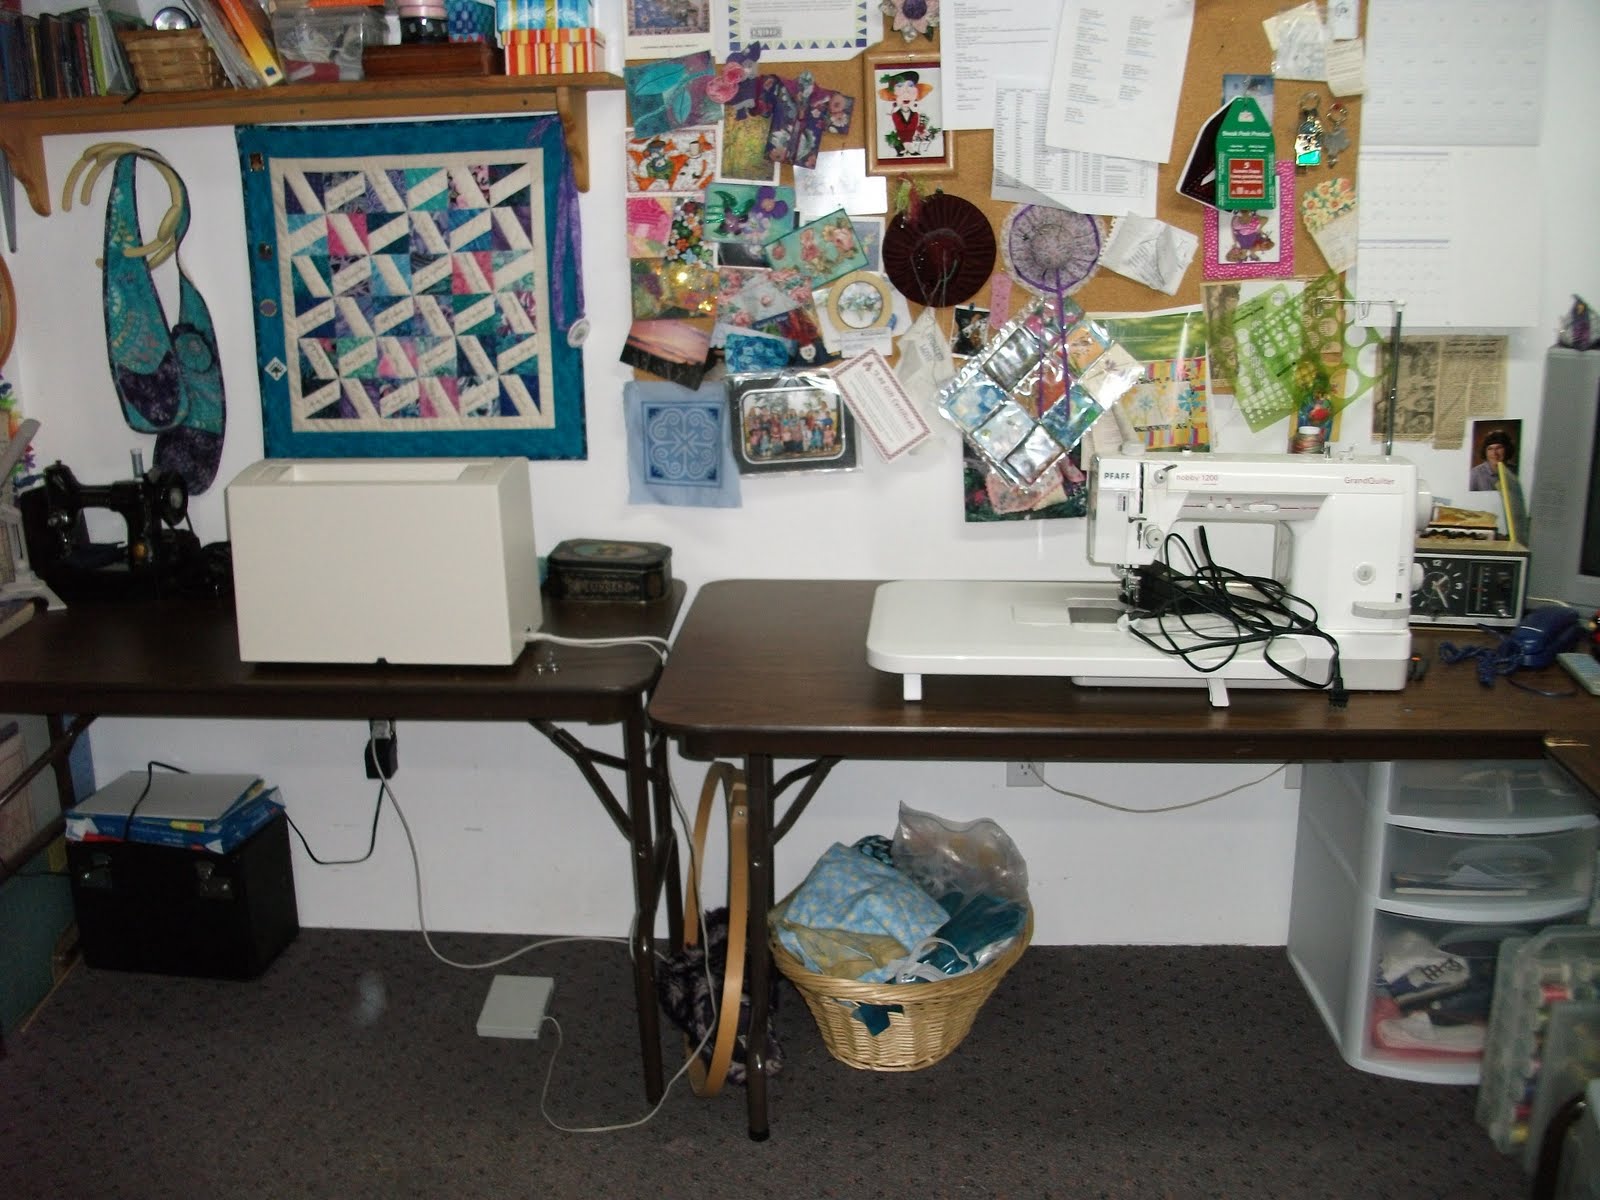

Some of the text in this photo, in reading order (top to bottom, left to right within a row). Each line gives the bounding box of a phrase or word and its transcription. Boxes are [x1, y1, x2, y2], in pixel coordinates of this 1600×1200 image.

[1104, 472, 1130, 480] PFAFF
[1176, 474, 1199, 482] hobby
[1344, 476, 1396, 485] GrandQuilter
